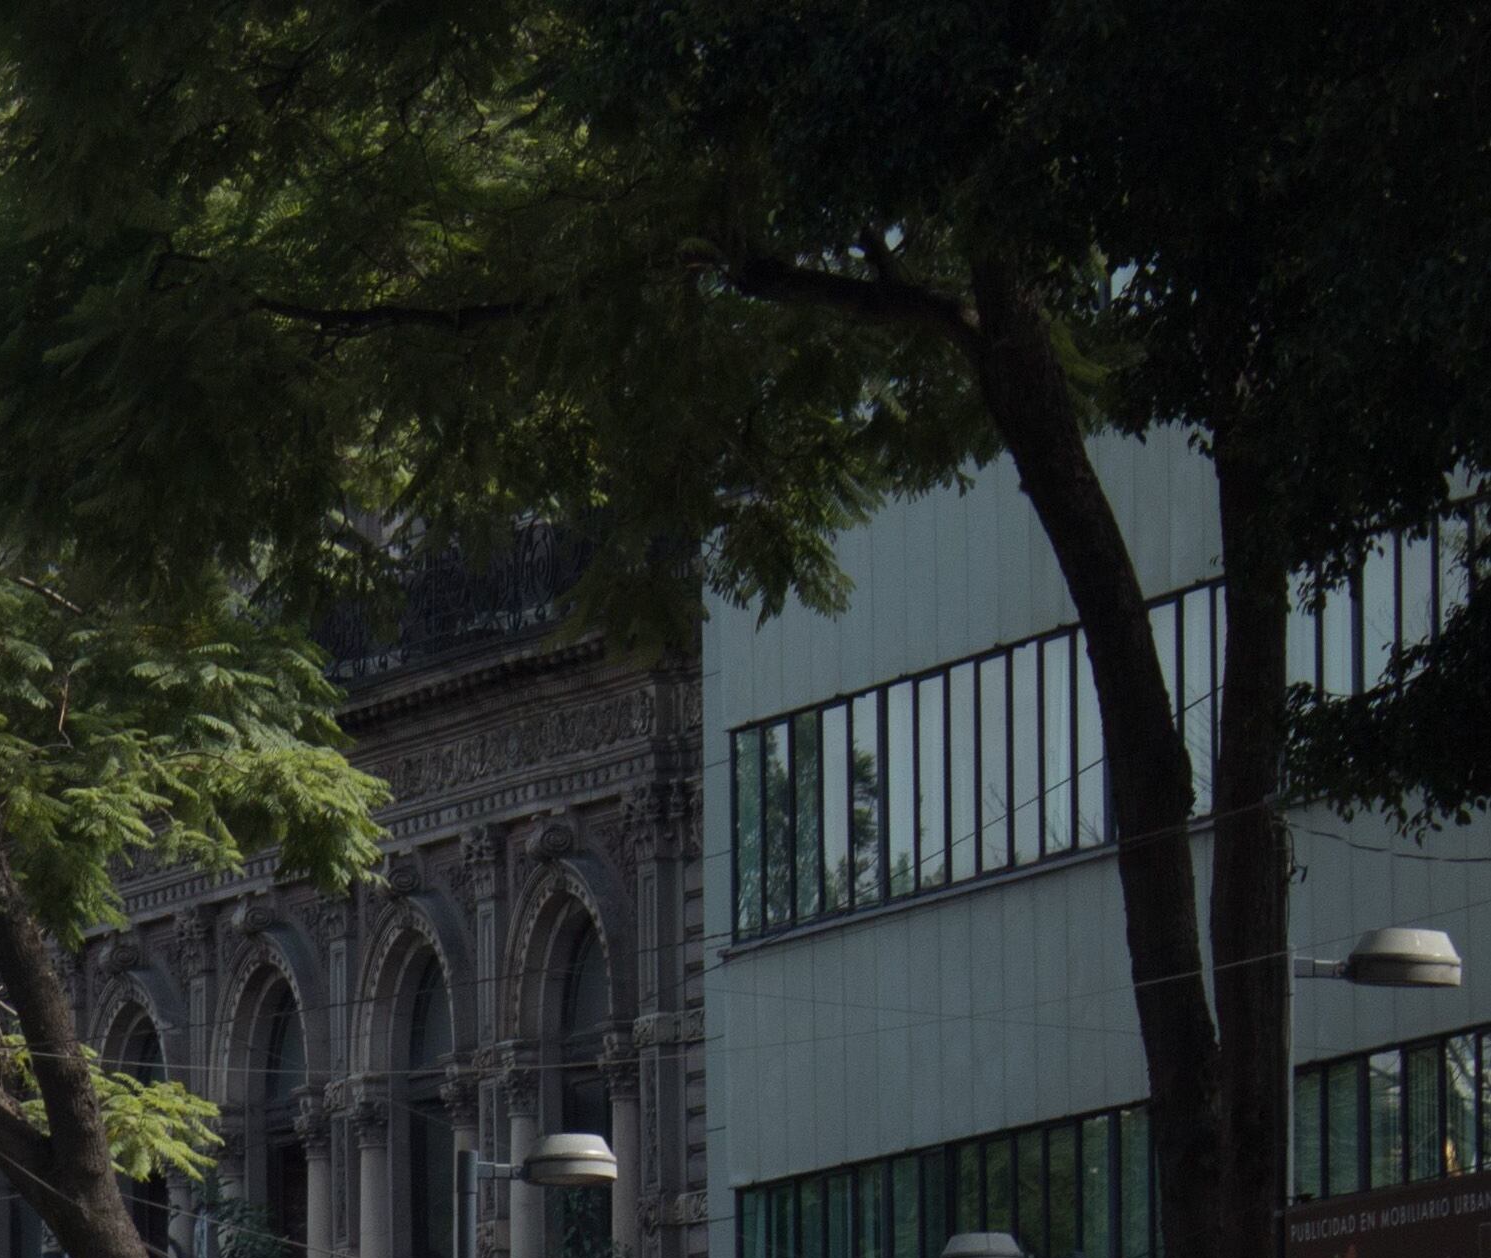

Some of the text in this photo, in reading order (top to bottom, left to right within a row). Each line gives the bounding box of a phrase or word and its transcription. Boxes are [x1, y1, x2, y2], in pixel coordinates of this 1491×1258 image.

[1290, 1215, 1356, 1242] PUBLICIDAD
[1360, 1212, 1375, 1232] EN
[1380, 1197, 1450, 1230] MOBILIARIO
